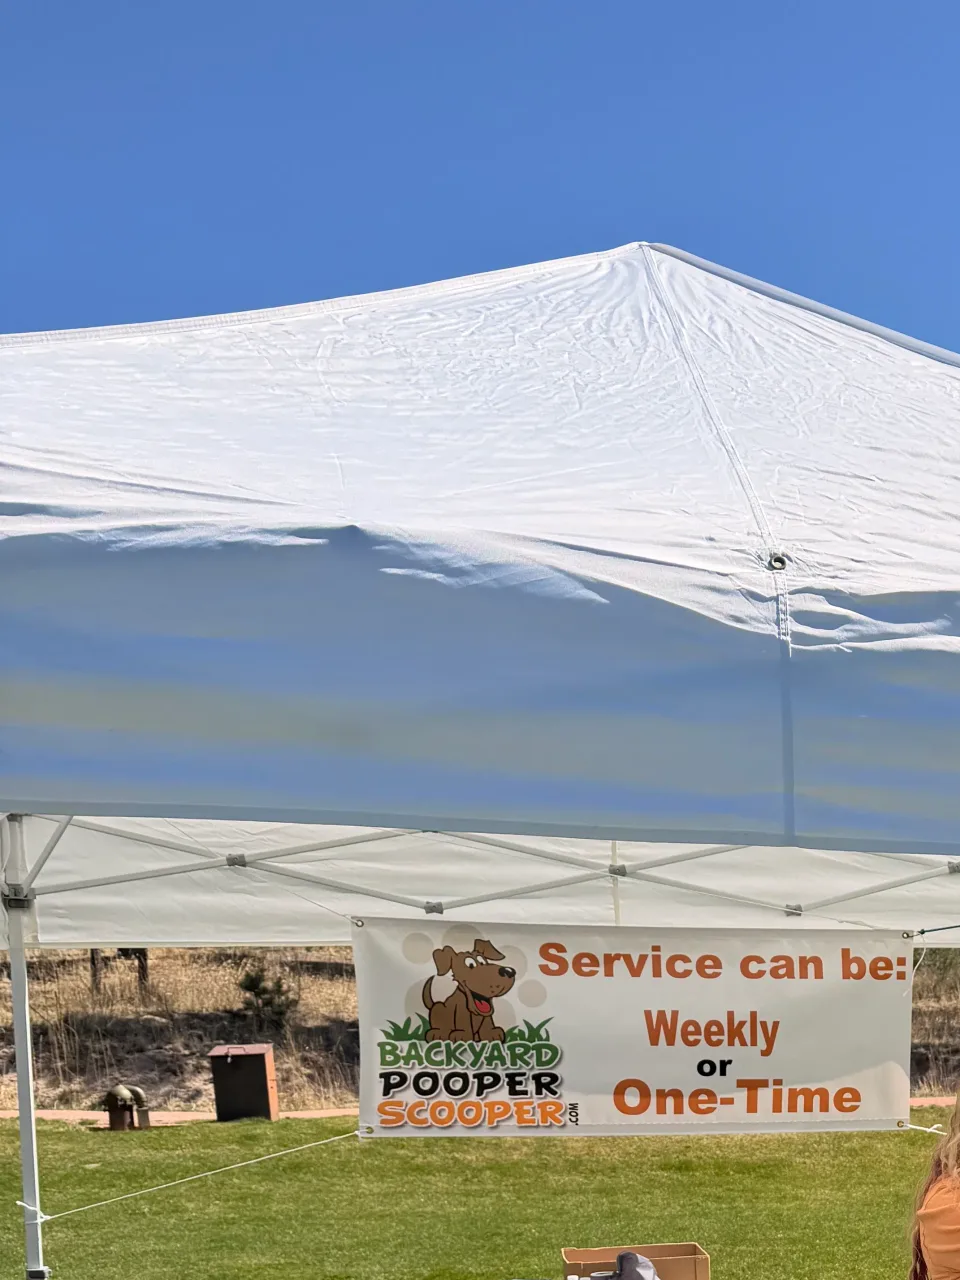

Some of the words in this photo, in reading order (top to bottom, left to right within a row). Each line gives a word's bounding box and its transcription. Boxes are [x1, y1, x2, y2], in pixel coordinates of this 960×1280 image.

[537, 942, 724, 979] Service
[739, 954, 824, 980] can
[841, 947, 907, 981] be:
[643, 1009, 781, 1057] Weekly
[377, 1041, 561, 1069] BACKYARD
[696, 1058, 733, 1077] or
[378, 1072, 561, 1097] POOPER
[613, 1078, 862, 1115] One-Time
[377, 1100, 565, 1127] SCOOPER
